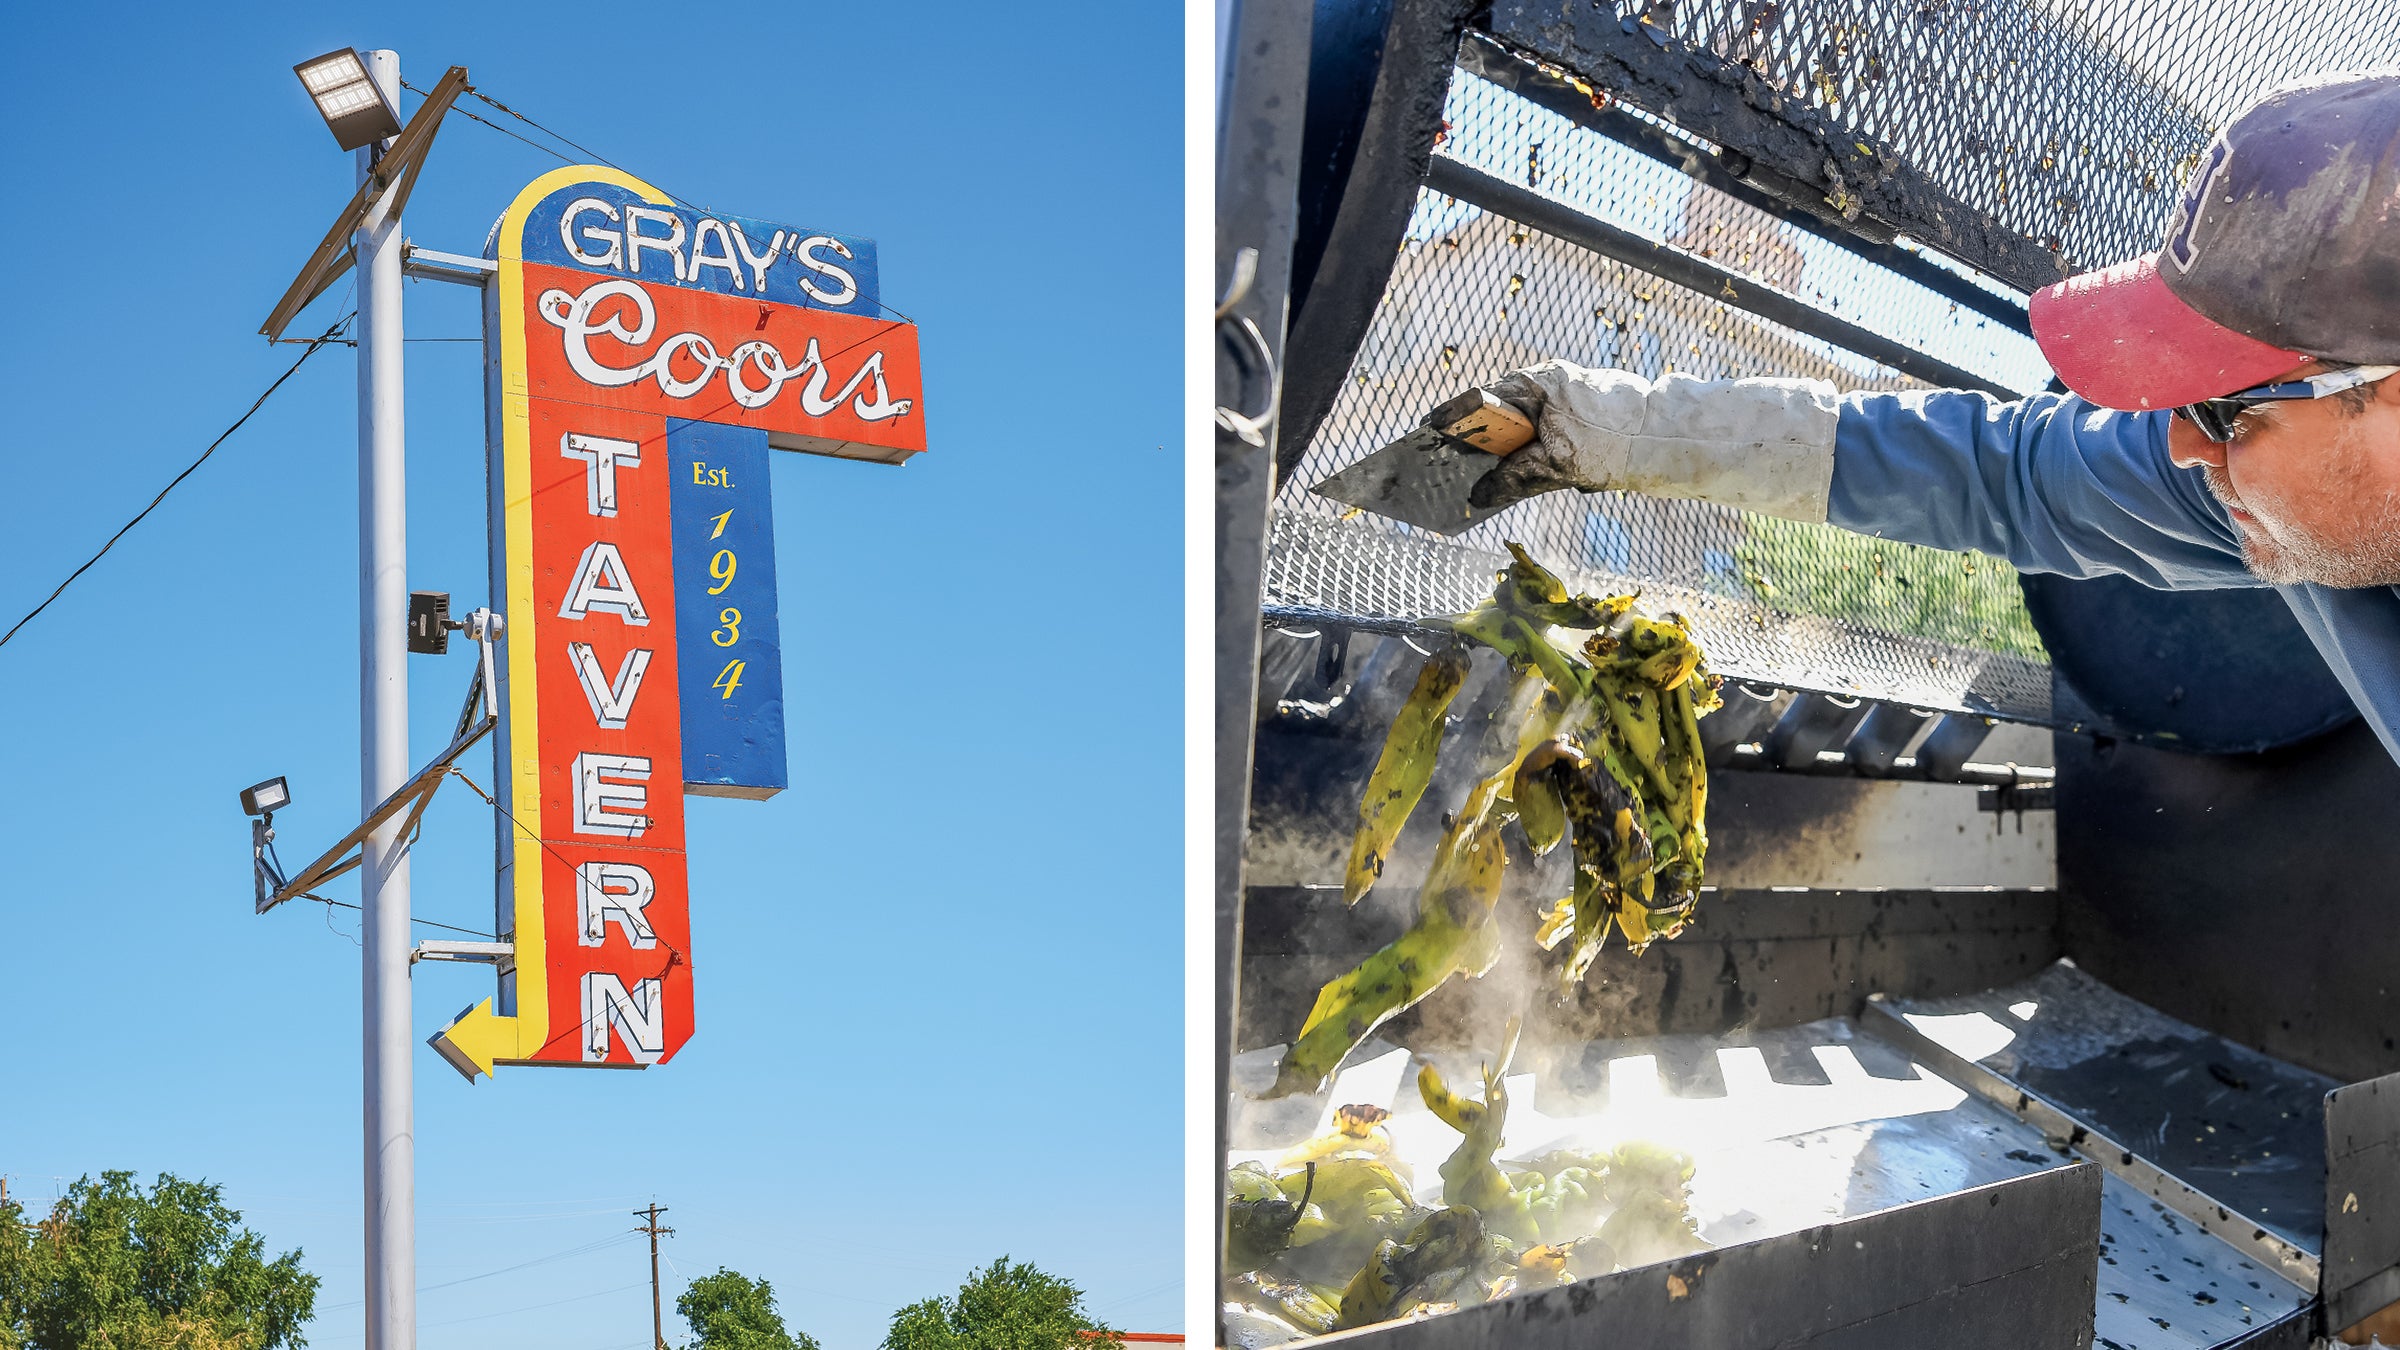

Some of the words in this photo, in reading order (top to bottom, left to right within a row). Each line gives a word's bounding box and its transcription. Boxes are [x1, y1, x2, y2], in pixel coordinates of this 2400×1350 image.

[559, 197, 858, 307] GRAY'S
[538, 280, 913, 422] Coors
[692, 461, 736, 489] Est.
[707, 507, 747, 700] 1934
[557, 431, 664, 1065] TAVERN
